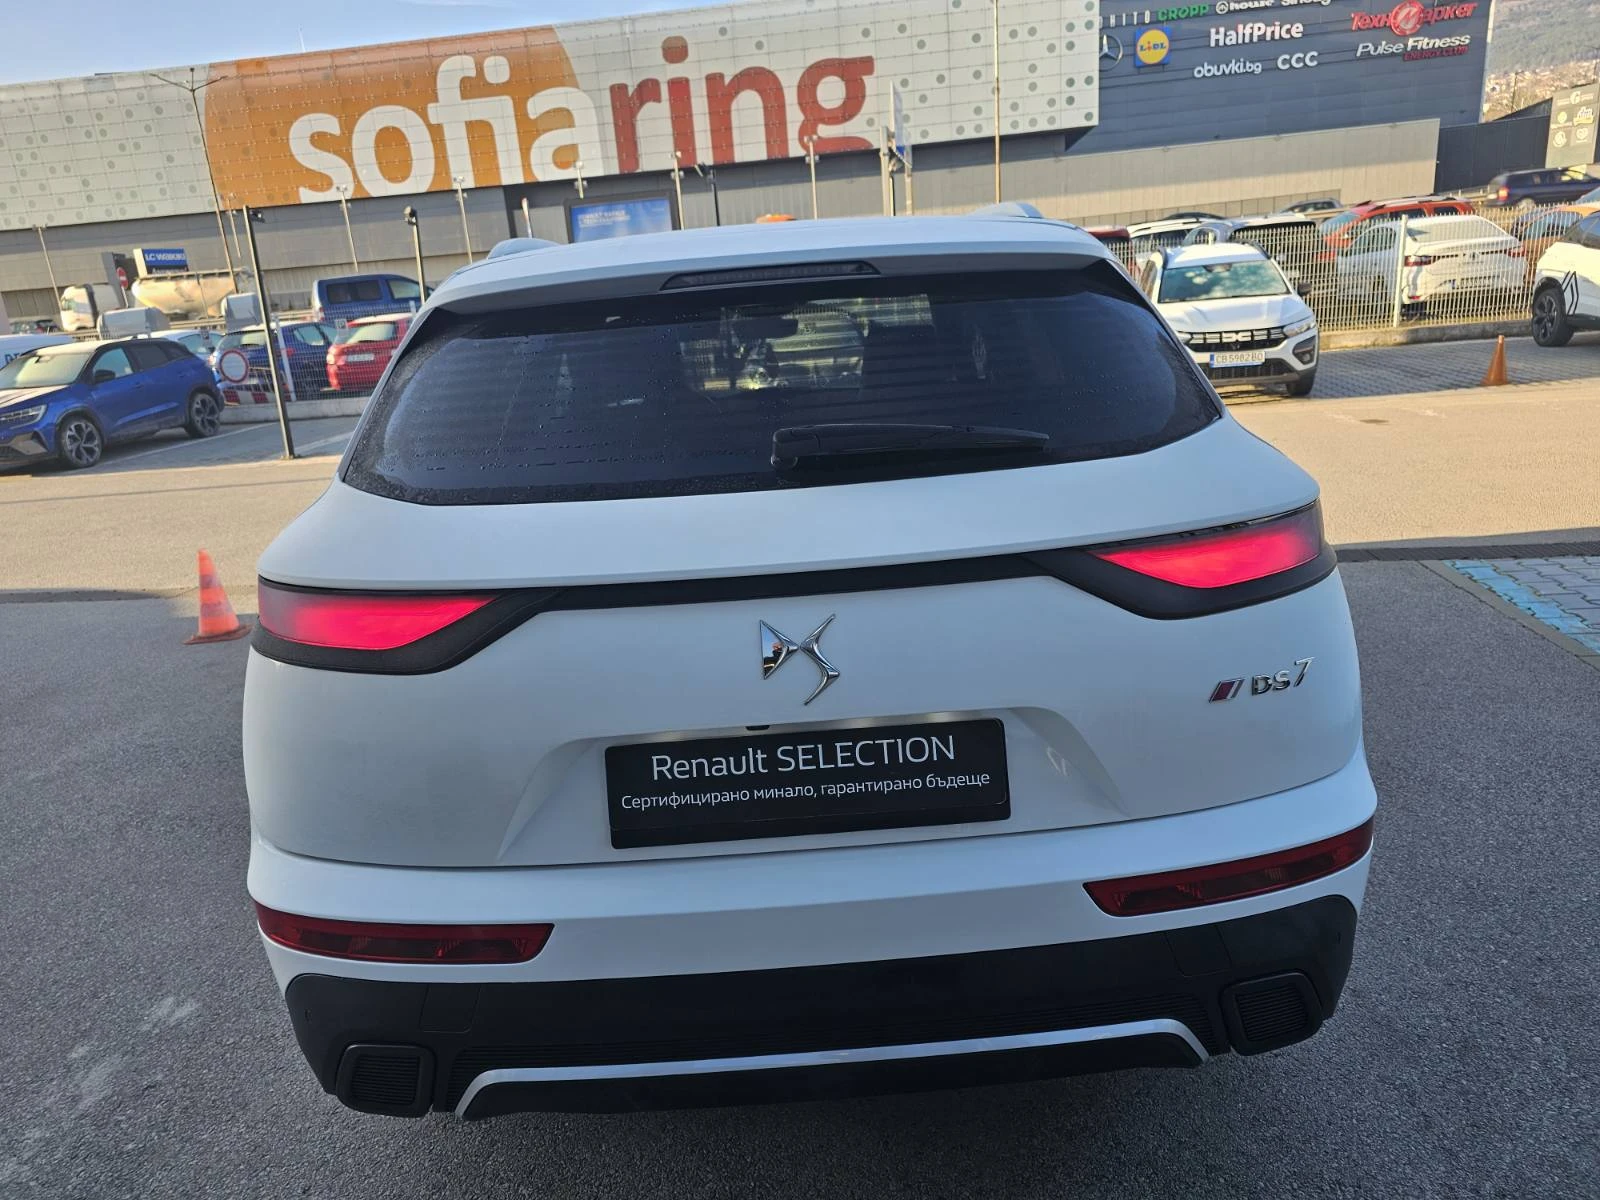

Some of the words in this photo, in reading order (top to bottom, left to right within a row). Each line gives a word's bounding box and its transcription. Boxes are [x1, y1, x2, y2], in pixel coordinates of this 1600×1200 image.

[1158, 4, 1209, 21] CROPP
[1209, 21, 1304, 47] HalfPrice
[1356, 40, 1403, 57] Pulse
[1407, 34, 1471, 51] Fitness
[1193, 57, 1263, 78] obuvki.bg
[1277, 51, 1319, 70] CCC
[651, 747, 769, 781] Renault
[776, 735, 956, 772] SELECTION
[621, 789, 750, 811] Сертифицирано
[753, 785, 818, 799] минало,
[821, 777, 922, 798] гарантирано
[926, 772, 991, 790] бъдеще
